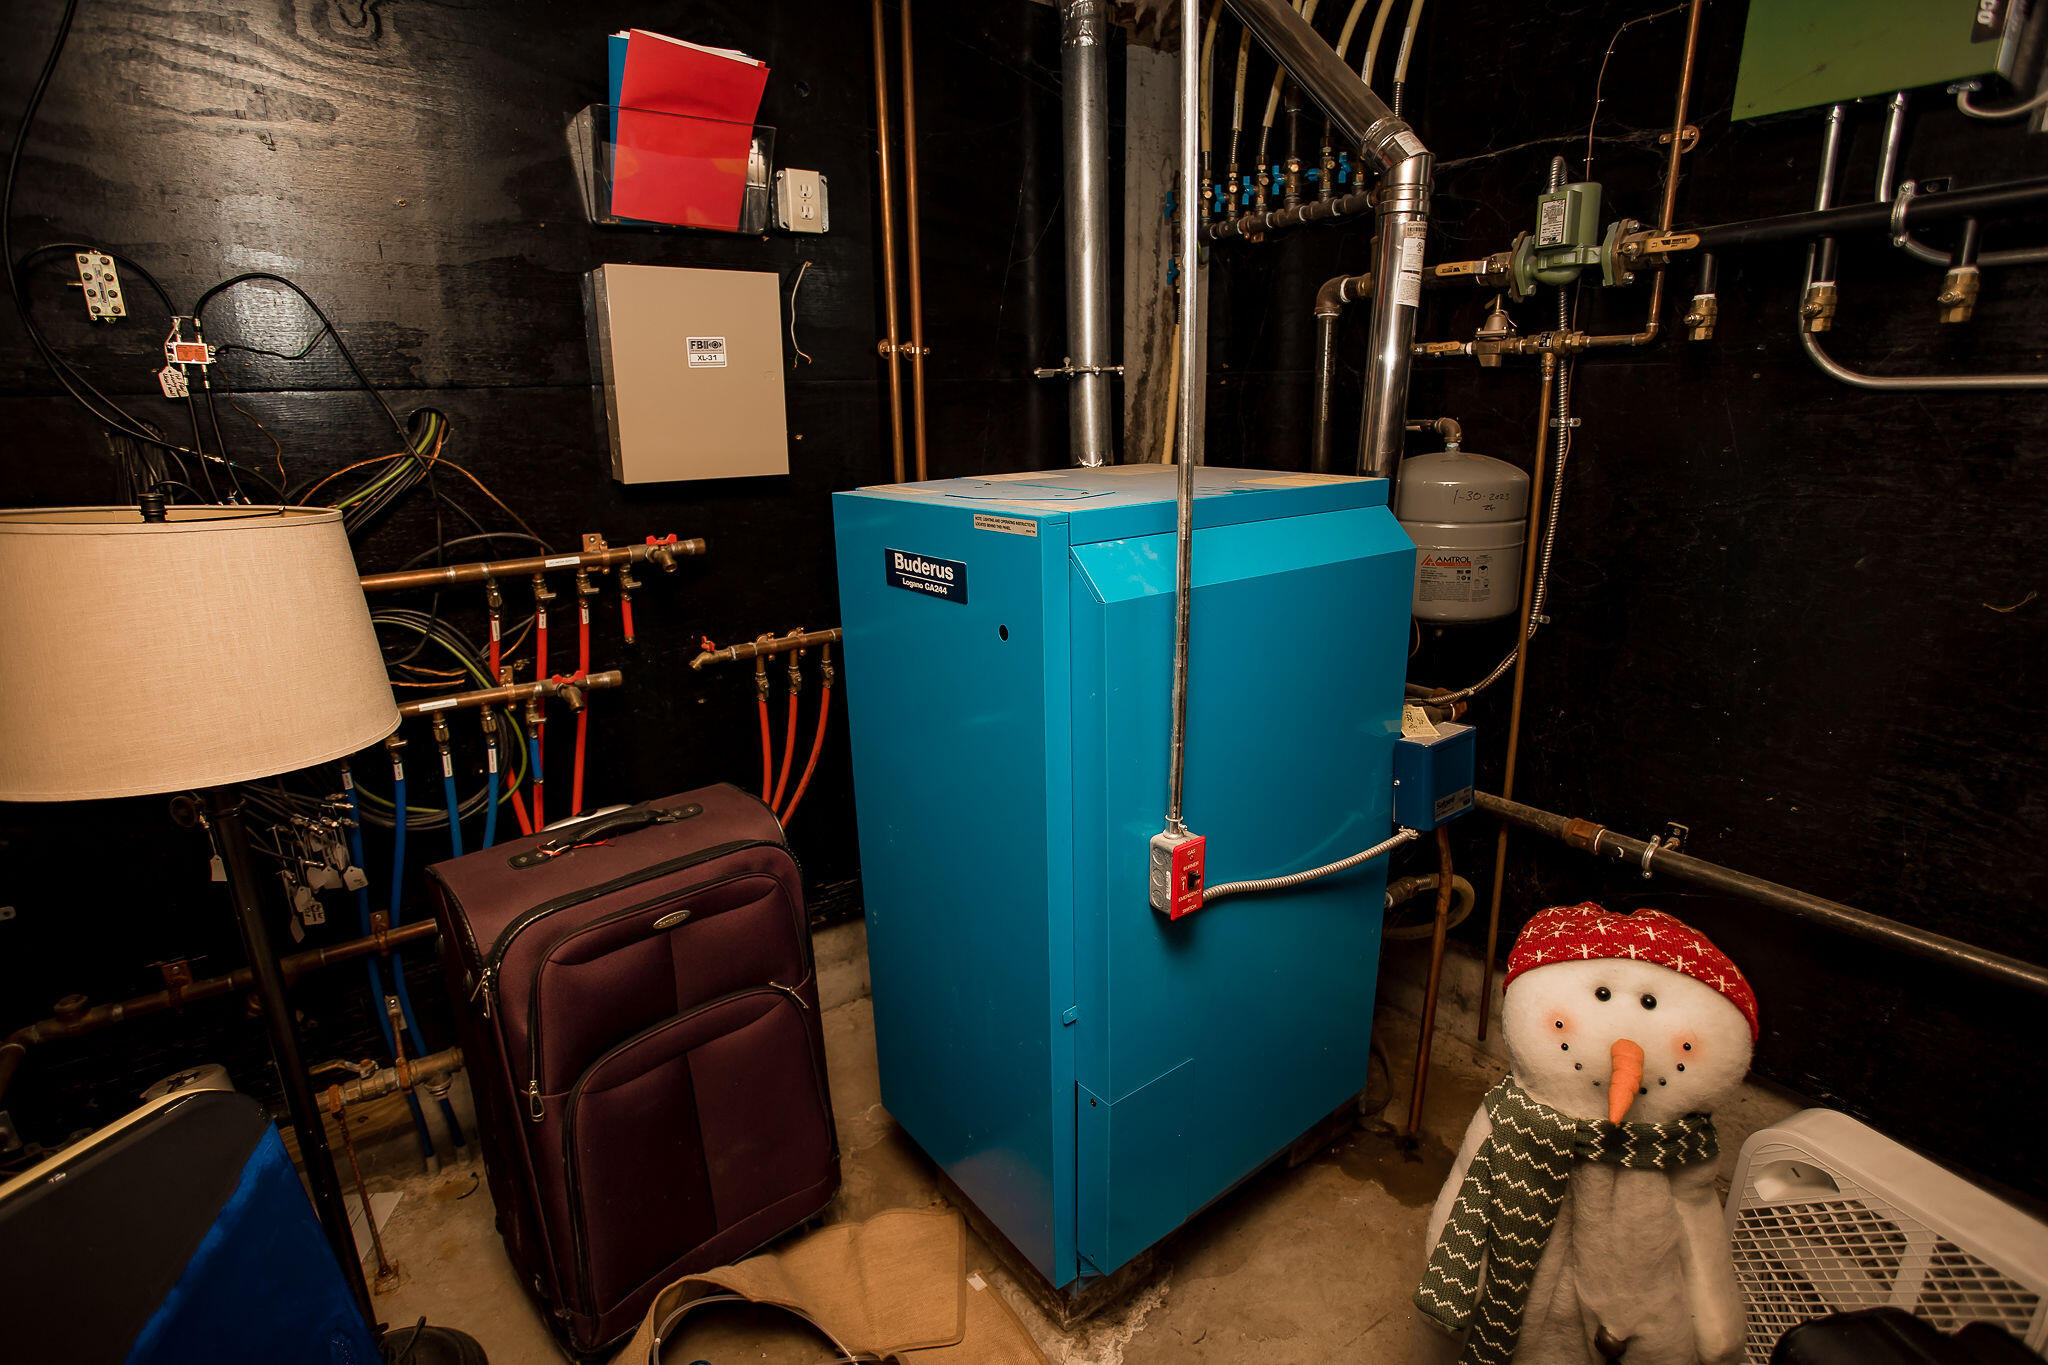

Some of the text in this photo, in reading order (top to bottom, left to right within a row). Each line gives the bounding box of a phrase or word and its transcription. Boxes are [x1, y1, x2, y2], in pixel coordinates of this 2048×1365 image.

[894, 552, 954, 581] Buderus
[902, 577, 948, 595] Logano GA244
[1187, 848, 1196, 856] GAS
[1183, 861, 1199, 872] BURNER
[1178, 889, 1202, 903] EMERGENCY
[1182, 904, 1197, 914] SWITCH
